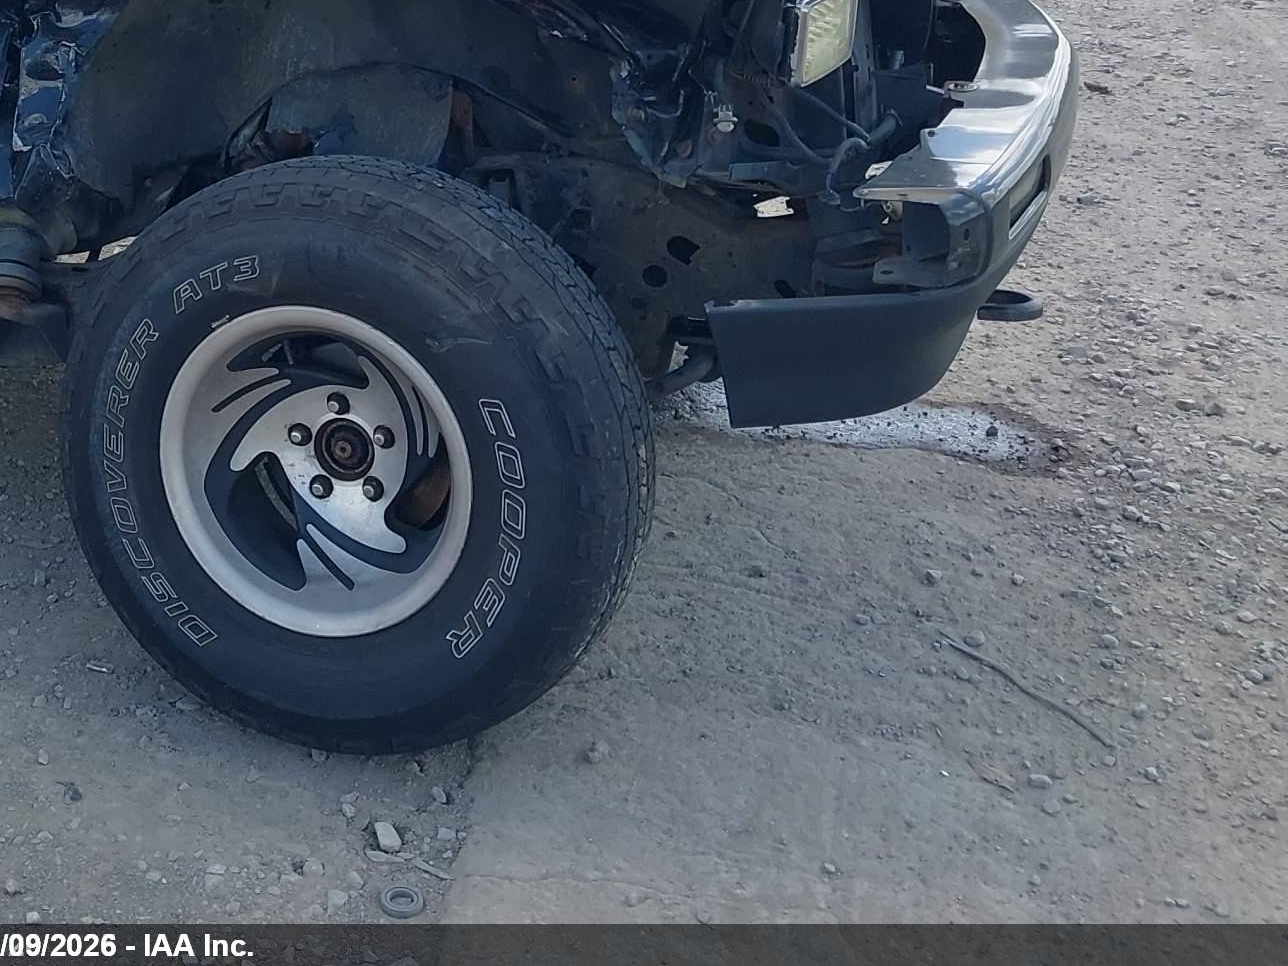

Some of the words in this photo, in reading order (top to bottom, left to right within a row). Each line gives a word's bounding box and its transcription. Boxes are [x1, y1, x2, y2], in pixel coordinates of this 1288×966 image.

[102, 318, 219, 647] DISCOVERER
[172, 254, 261, 315] AT3
[445, 398, 527, 659] COOPER
